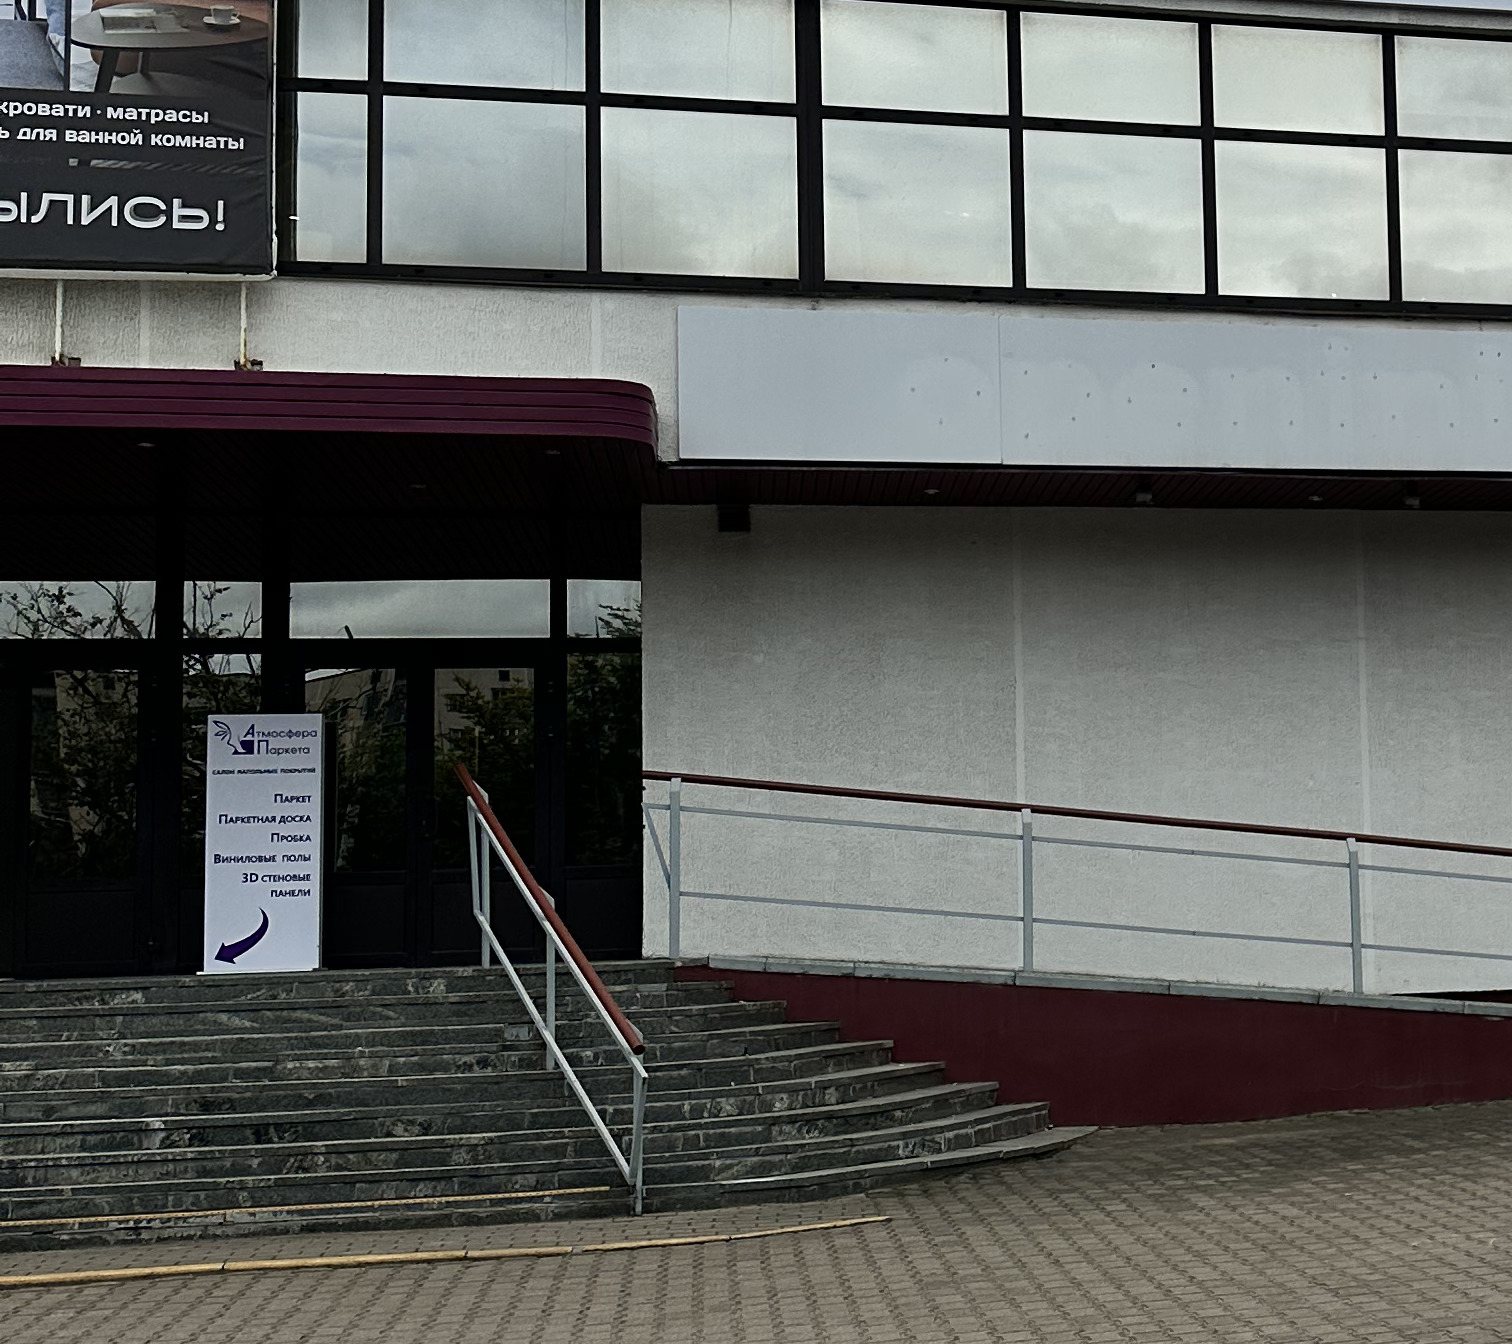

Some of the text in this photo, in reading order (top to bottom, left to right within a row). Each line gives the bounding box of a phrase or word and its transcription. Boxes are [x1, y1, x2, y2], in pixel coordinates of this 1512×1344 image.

[106, 106, 209, 124] матрасы
[17, 128, 57, 141] для
[65, 129, 143, 146] ванной
[151, 133, 244, 150] комнаты
[242, 873, 258, 883] 3D
